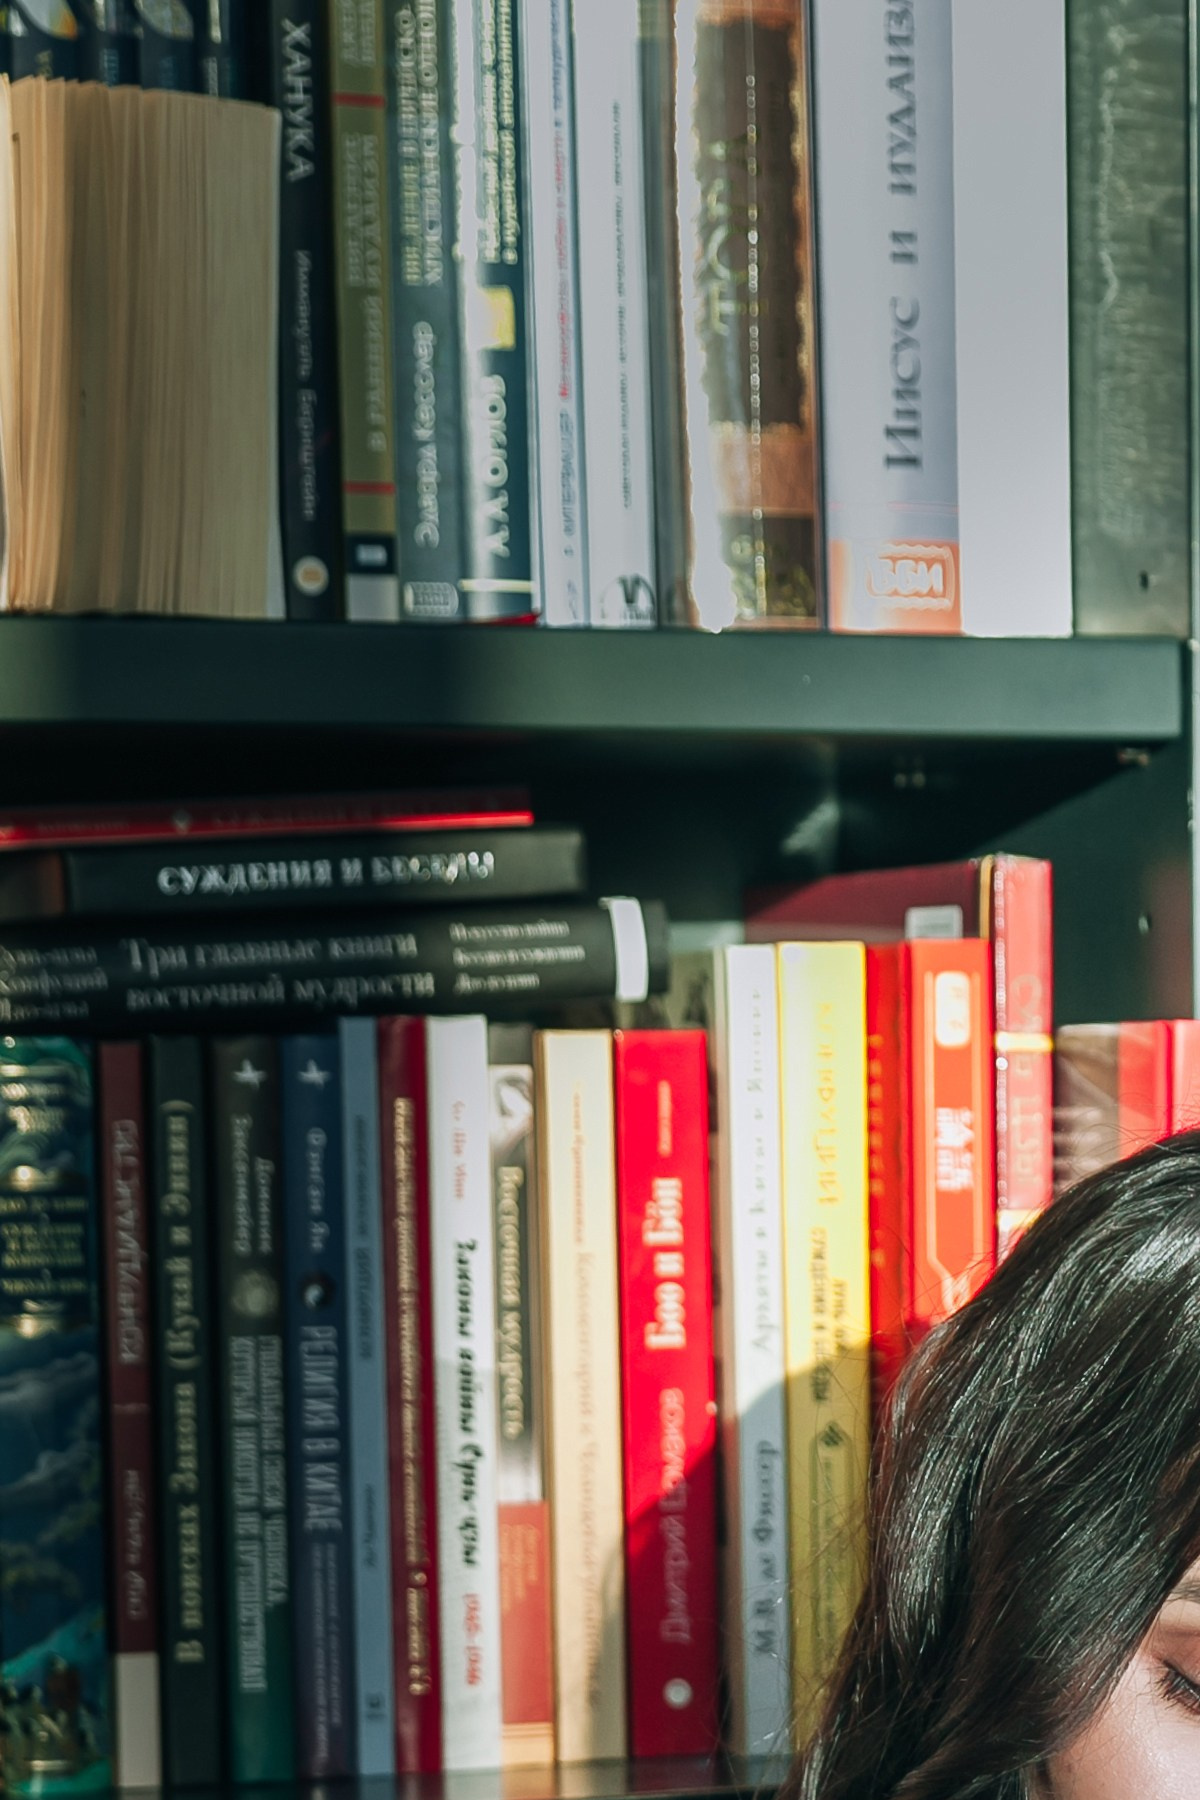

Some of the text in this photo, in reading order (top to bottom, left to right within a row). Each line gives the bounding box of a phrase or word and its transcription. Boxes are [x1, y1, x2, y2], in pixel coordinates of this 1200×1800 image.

[280, 17, 316, 183] ХАНУКА
[888, 230, 918, 265] и
[884, 297, 923, 473] Иисус
[157, 849, 496, 897] СУЖДЕНИЯ И БЕСЕДЫ
[119, 931, 419, 983] Три главные книги
[127, 968, 436, 1012] восточной мудрости
[169, 1225, 193, 1247] и
[652, 1251, 685, 1279] и
[454, 1238, 481, 1340] Законы
[496, 1165, 527, 1441] Восточная мудрость
[298, 1324, 339, 1433] РЕЛИГИЯ
[456, 1346, 484, 1434] войны
[167, 1381, 200, 1495] Закона
[301, 1436, 341, 1457] В
[303, 1461, 343, 1534] КИТАЕ
[656, 1387, 692, 1642] Дмитрий Ермаков
[176, 1503, 204, 1630] поисках
[172, 1639, 206, 1664] В
